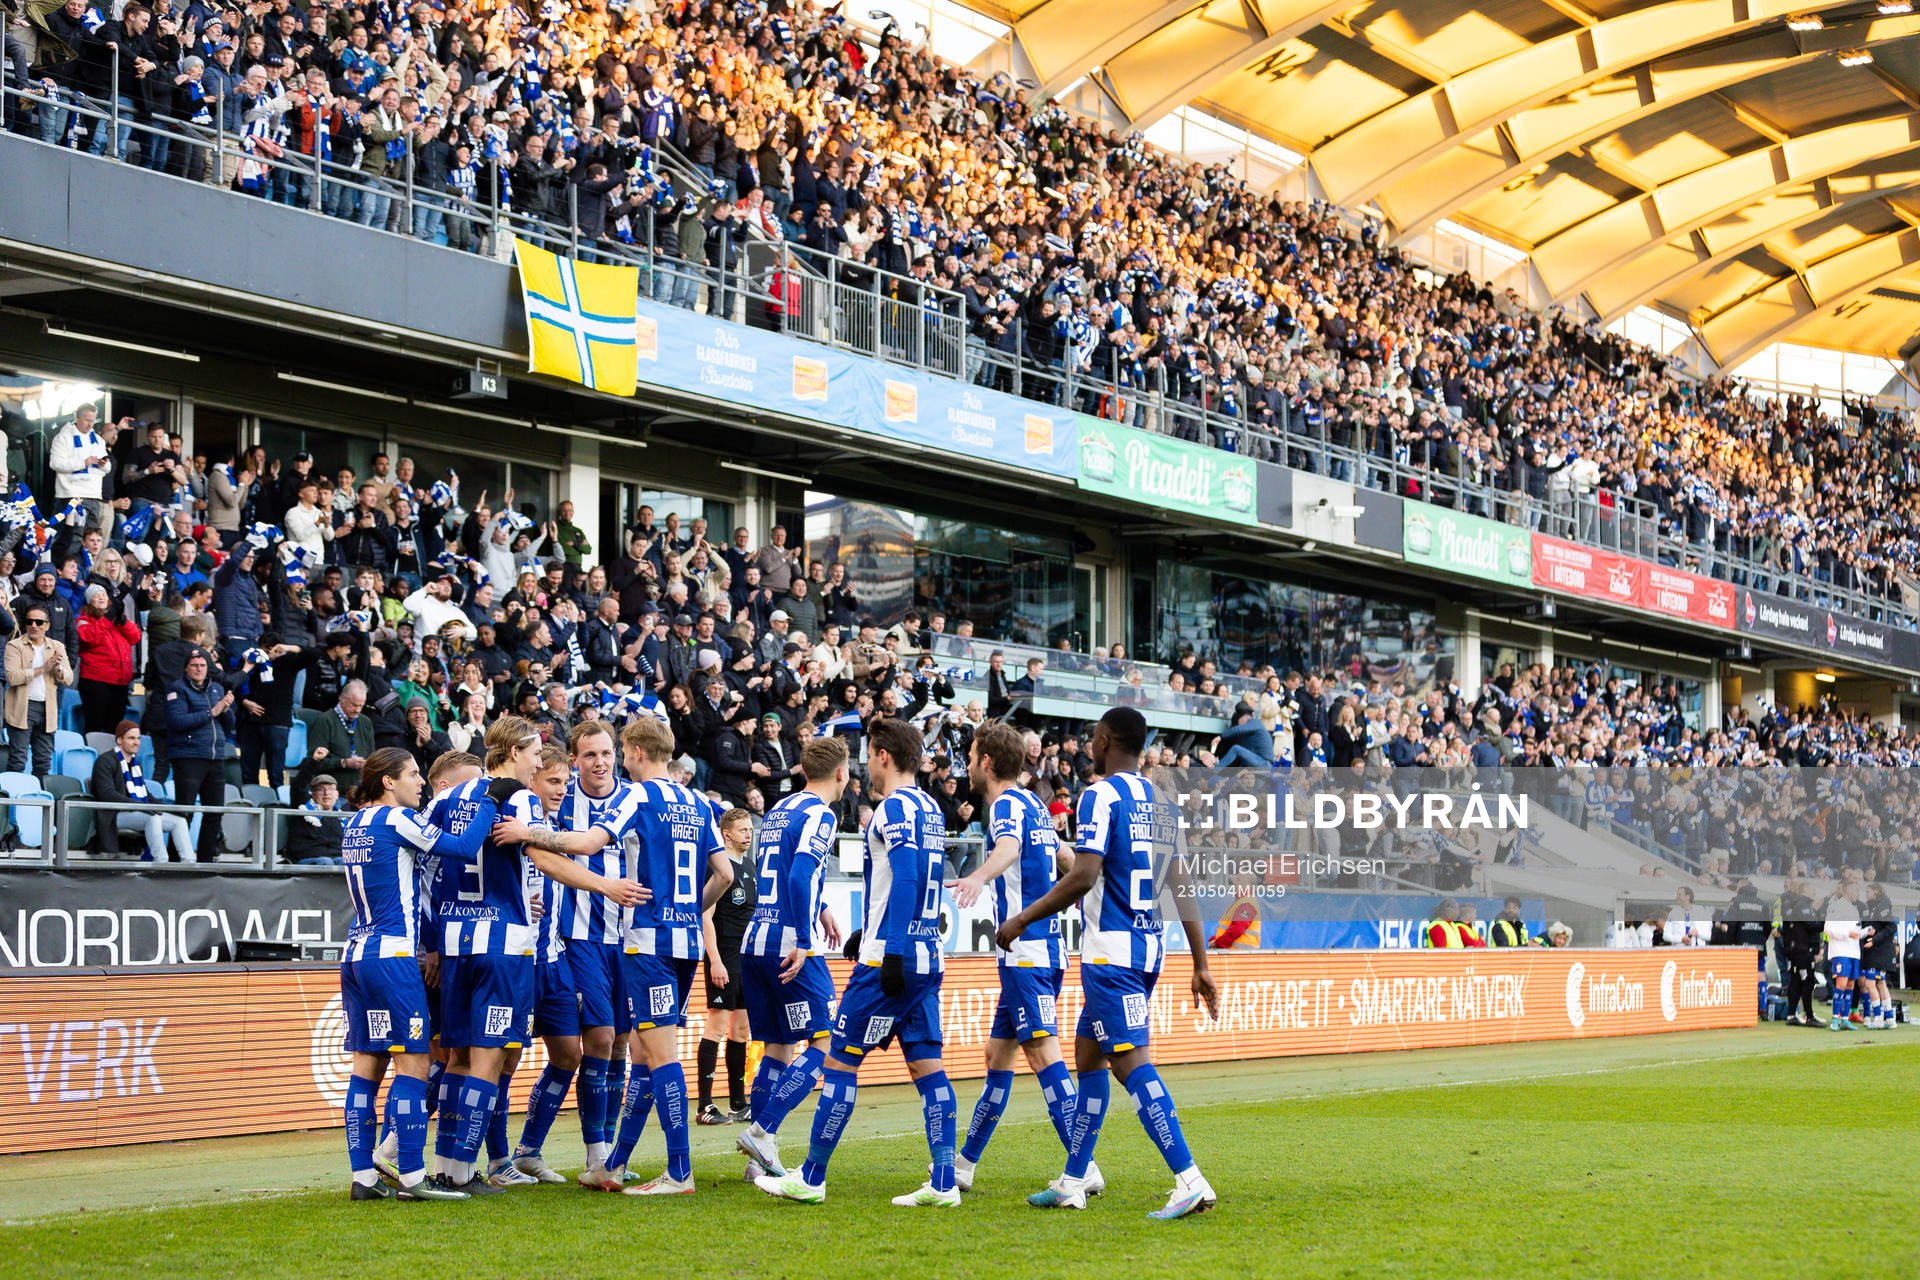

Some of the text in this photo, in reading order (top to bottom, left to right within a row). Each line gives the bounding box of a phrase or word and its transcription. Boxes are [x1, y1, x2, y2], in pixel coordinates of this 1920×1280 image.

[482, 376, 496, 393] K3
[1125, 439, 1211, 506] Picadeli
[1438, 517, 1500, 572] Picadeli
[668, 803, 698, 815] NORDIC
[768, 811, 789, 820] NORDIC
[658, 812, 704, 826] WELLNESS
[671, 823, 699, 841] HAGEN
[674, 840, 698, 905] 8
[1130, 841, 1175, 912] 20
[921, 852, 942, 919] 6
[652, 987, 669, 997] EFF
[1350, 966, 1525, 1026] SMARTARE NÄTVERK
[1589, 968, 1644, 1014] InfraCom
[1679, 967, 1732, 1009] InfraCom
[653, 994, 672, 1005] EKT
[787, 1004, 804, 1012] EFF
[1193, 979, 1334, 1034] SMARTARE IT
[369, 1011, 386, 1021] EFF
[490, 1007, 508, 1017] EFF
[653, 1004, 665, 1013] IV
[789, 1011, 808, 1020] EKT
[1017, 1007, 1026, 1022] 2
[371, 1020, 389, 1029] EKT
[488, 1025, 499, 1033] IV
[489, 1016, 510, 1026] EKT
[791, 1019, 801, 1028] IV
[837, 1013, 847, 1030] 6
[871, 1018, 890, 1027] EFF
[1091, 1020, 1105, 1037] 20
[371, 1028, 381, 1037] IV
[866, 1033, 879, 1042] IV
[869, 1026, 889, 1035] EKT
[776, 1069, 806, 1101] SILFVERLOK
[623, 1080, 641, 1119] SILFVERLOK
[665, 1081, 684, 1129] SILFVERLOK
[820, 1102, 848, 1141] SILFVERLOK
[928, 1103, 943, 1145] SILFVERLOK
[968, 1101, 991, 1138] SILFVERLOK
[1146, 1102, 1175, 1150] SILFVERLOK
[347, 1109, 360, 1150] SILFVERLOK
[1070, 1113, 1091, 1157] SILFVERLOK
